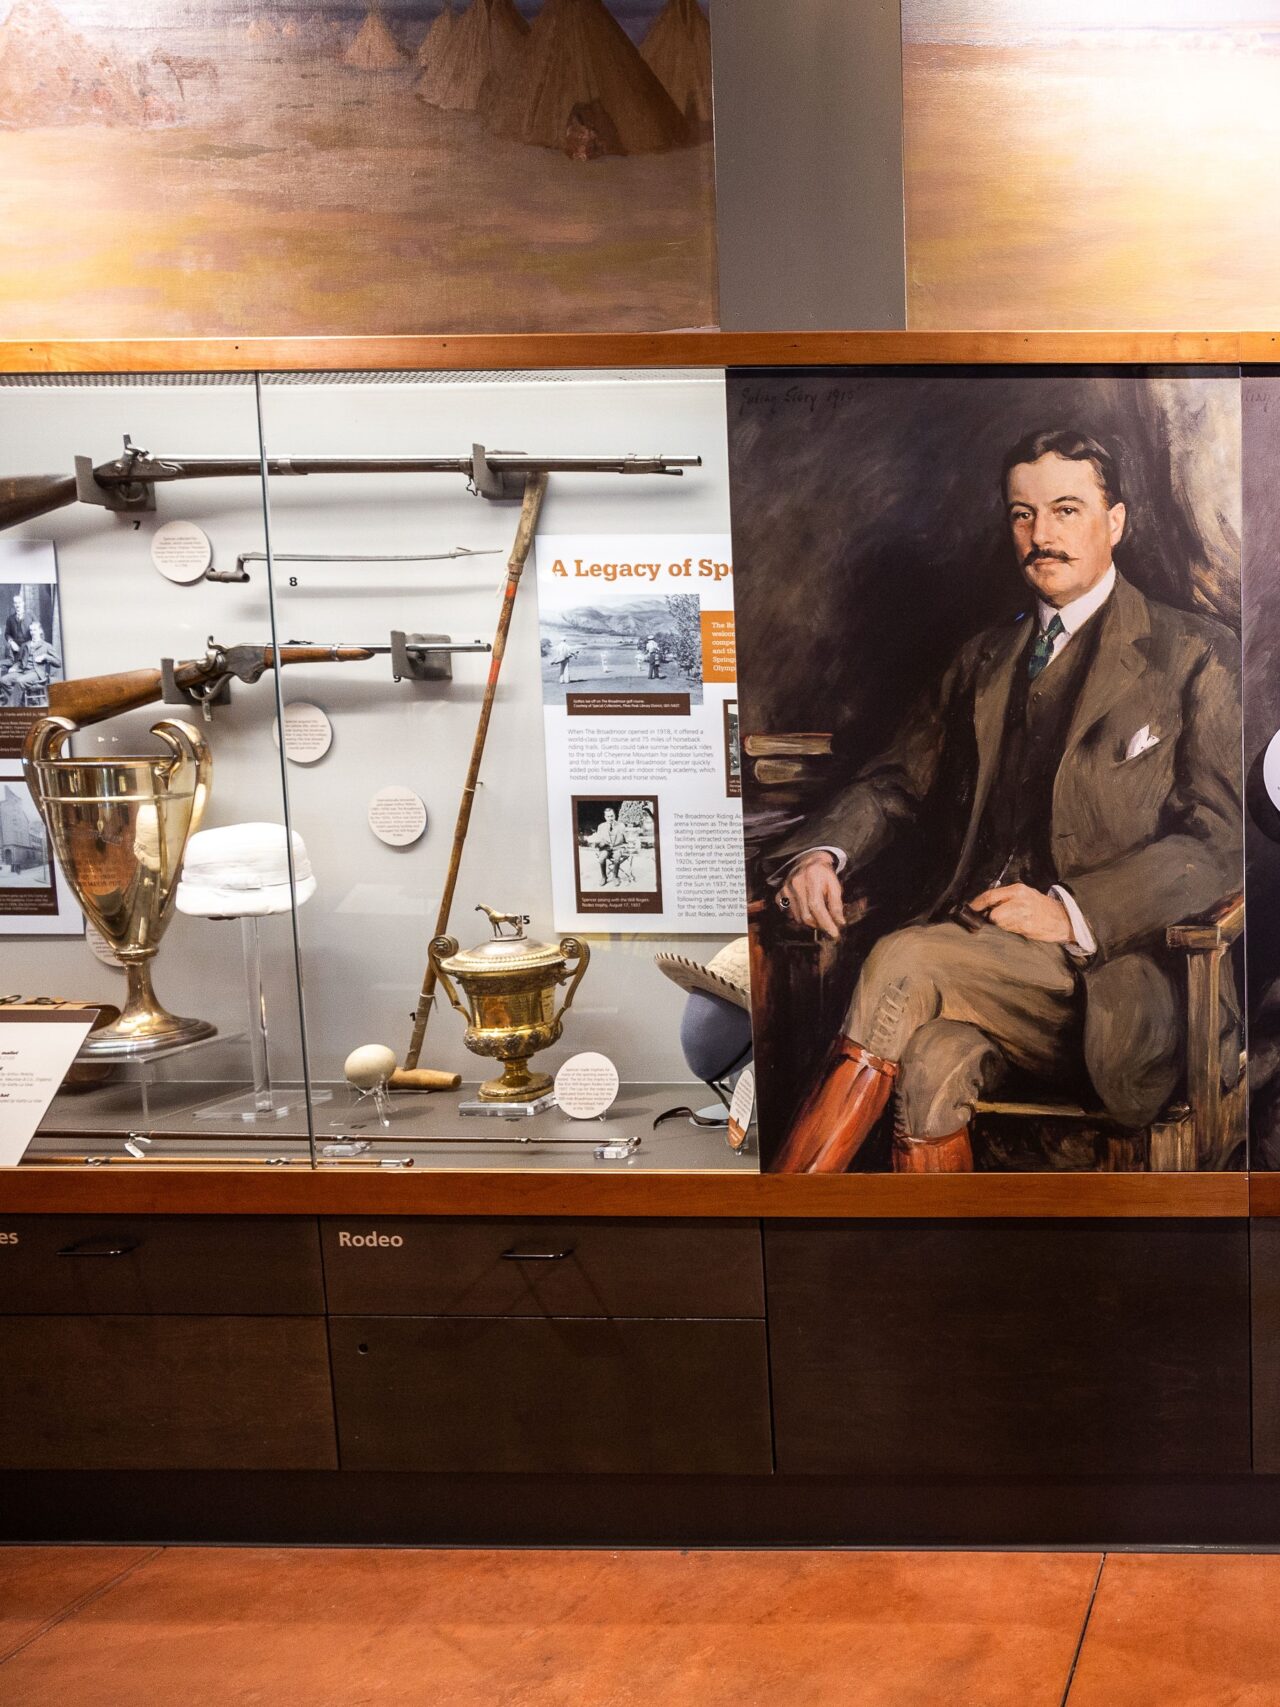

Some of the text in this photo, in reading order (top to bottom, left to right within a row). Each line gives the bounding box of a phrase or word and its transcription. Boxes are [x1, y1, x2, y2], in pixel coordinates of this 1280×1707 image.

[133, 521, 141, 530] 7
[551, 559, 568, 576] A
[574, 560, 661, 581] Legacy
[668, 558, 692, 576] of
[289, 577, 298, 587] 8
[339, 1231, 403, 1247] Rodeo
